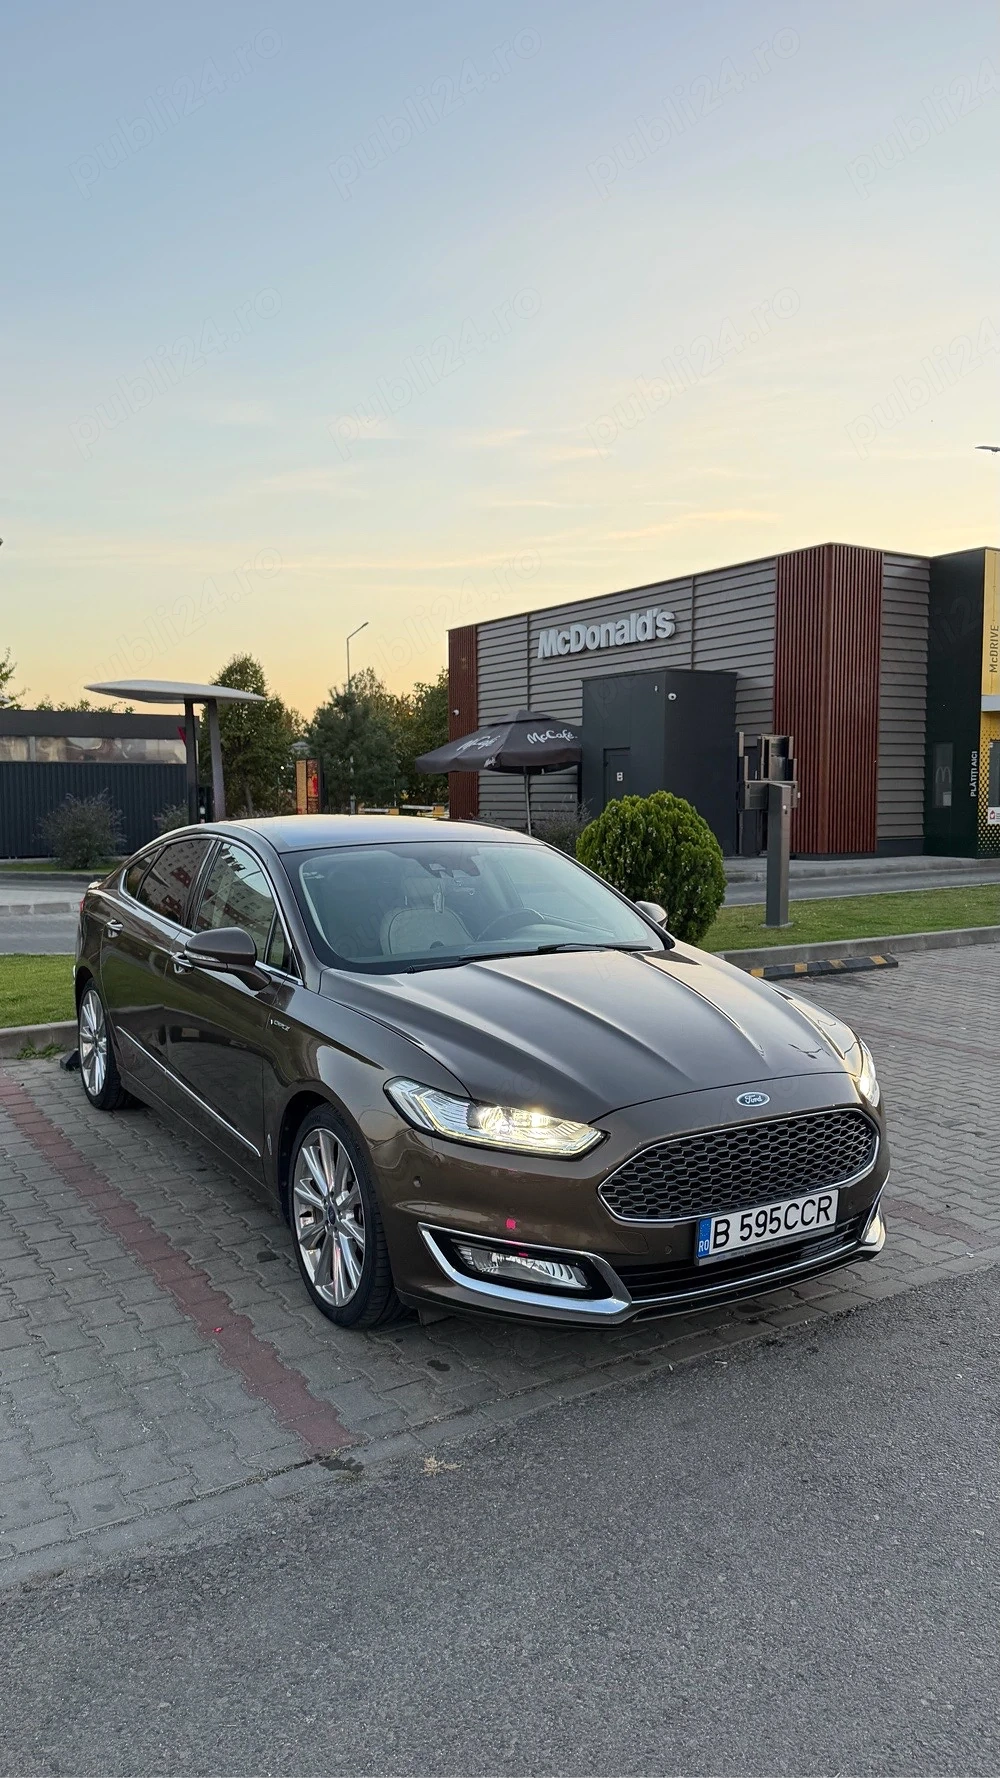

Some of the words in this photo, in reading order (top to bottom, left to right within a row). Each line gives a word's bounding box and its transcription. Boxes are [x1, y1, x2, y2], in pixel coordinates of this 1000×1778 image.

[537, 607, 676, 660] McDonald's
[988, 624, 1000, 673] McDRIVE
[526, 729, 575, 745] McCafé
[970, 750, 978, 767] AICI
[744, 1094, 763, 1104] Ford
[712, 1218, 731, 1249] B
[698, 1239, 710, 1253] RO
